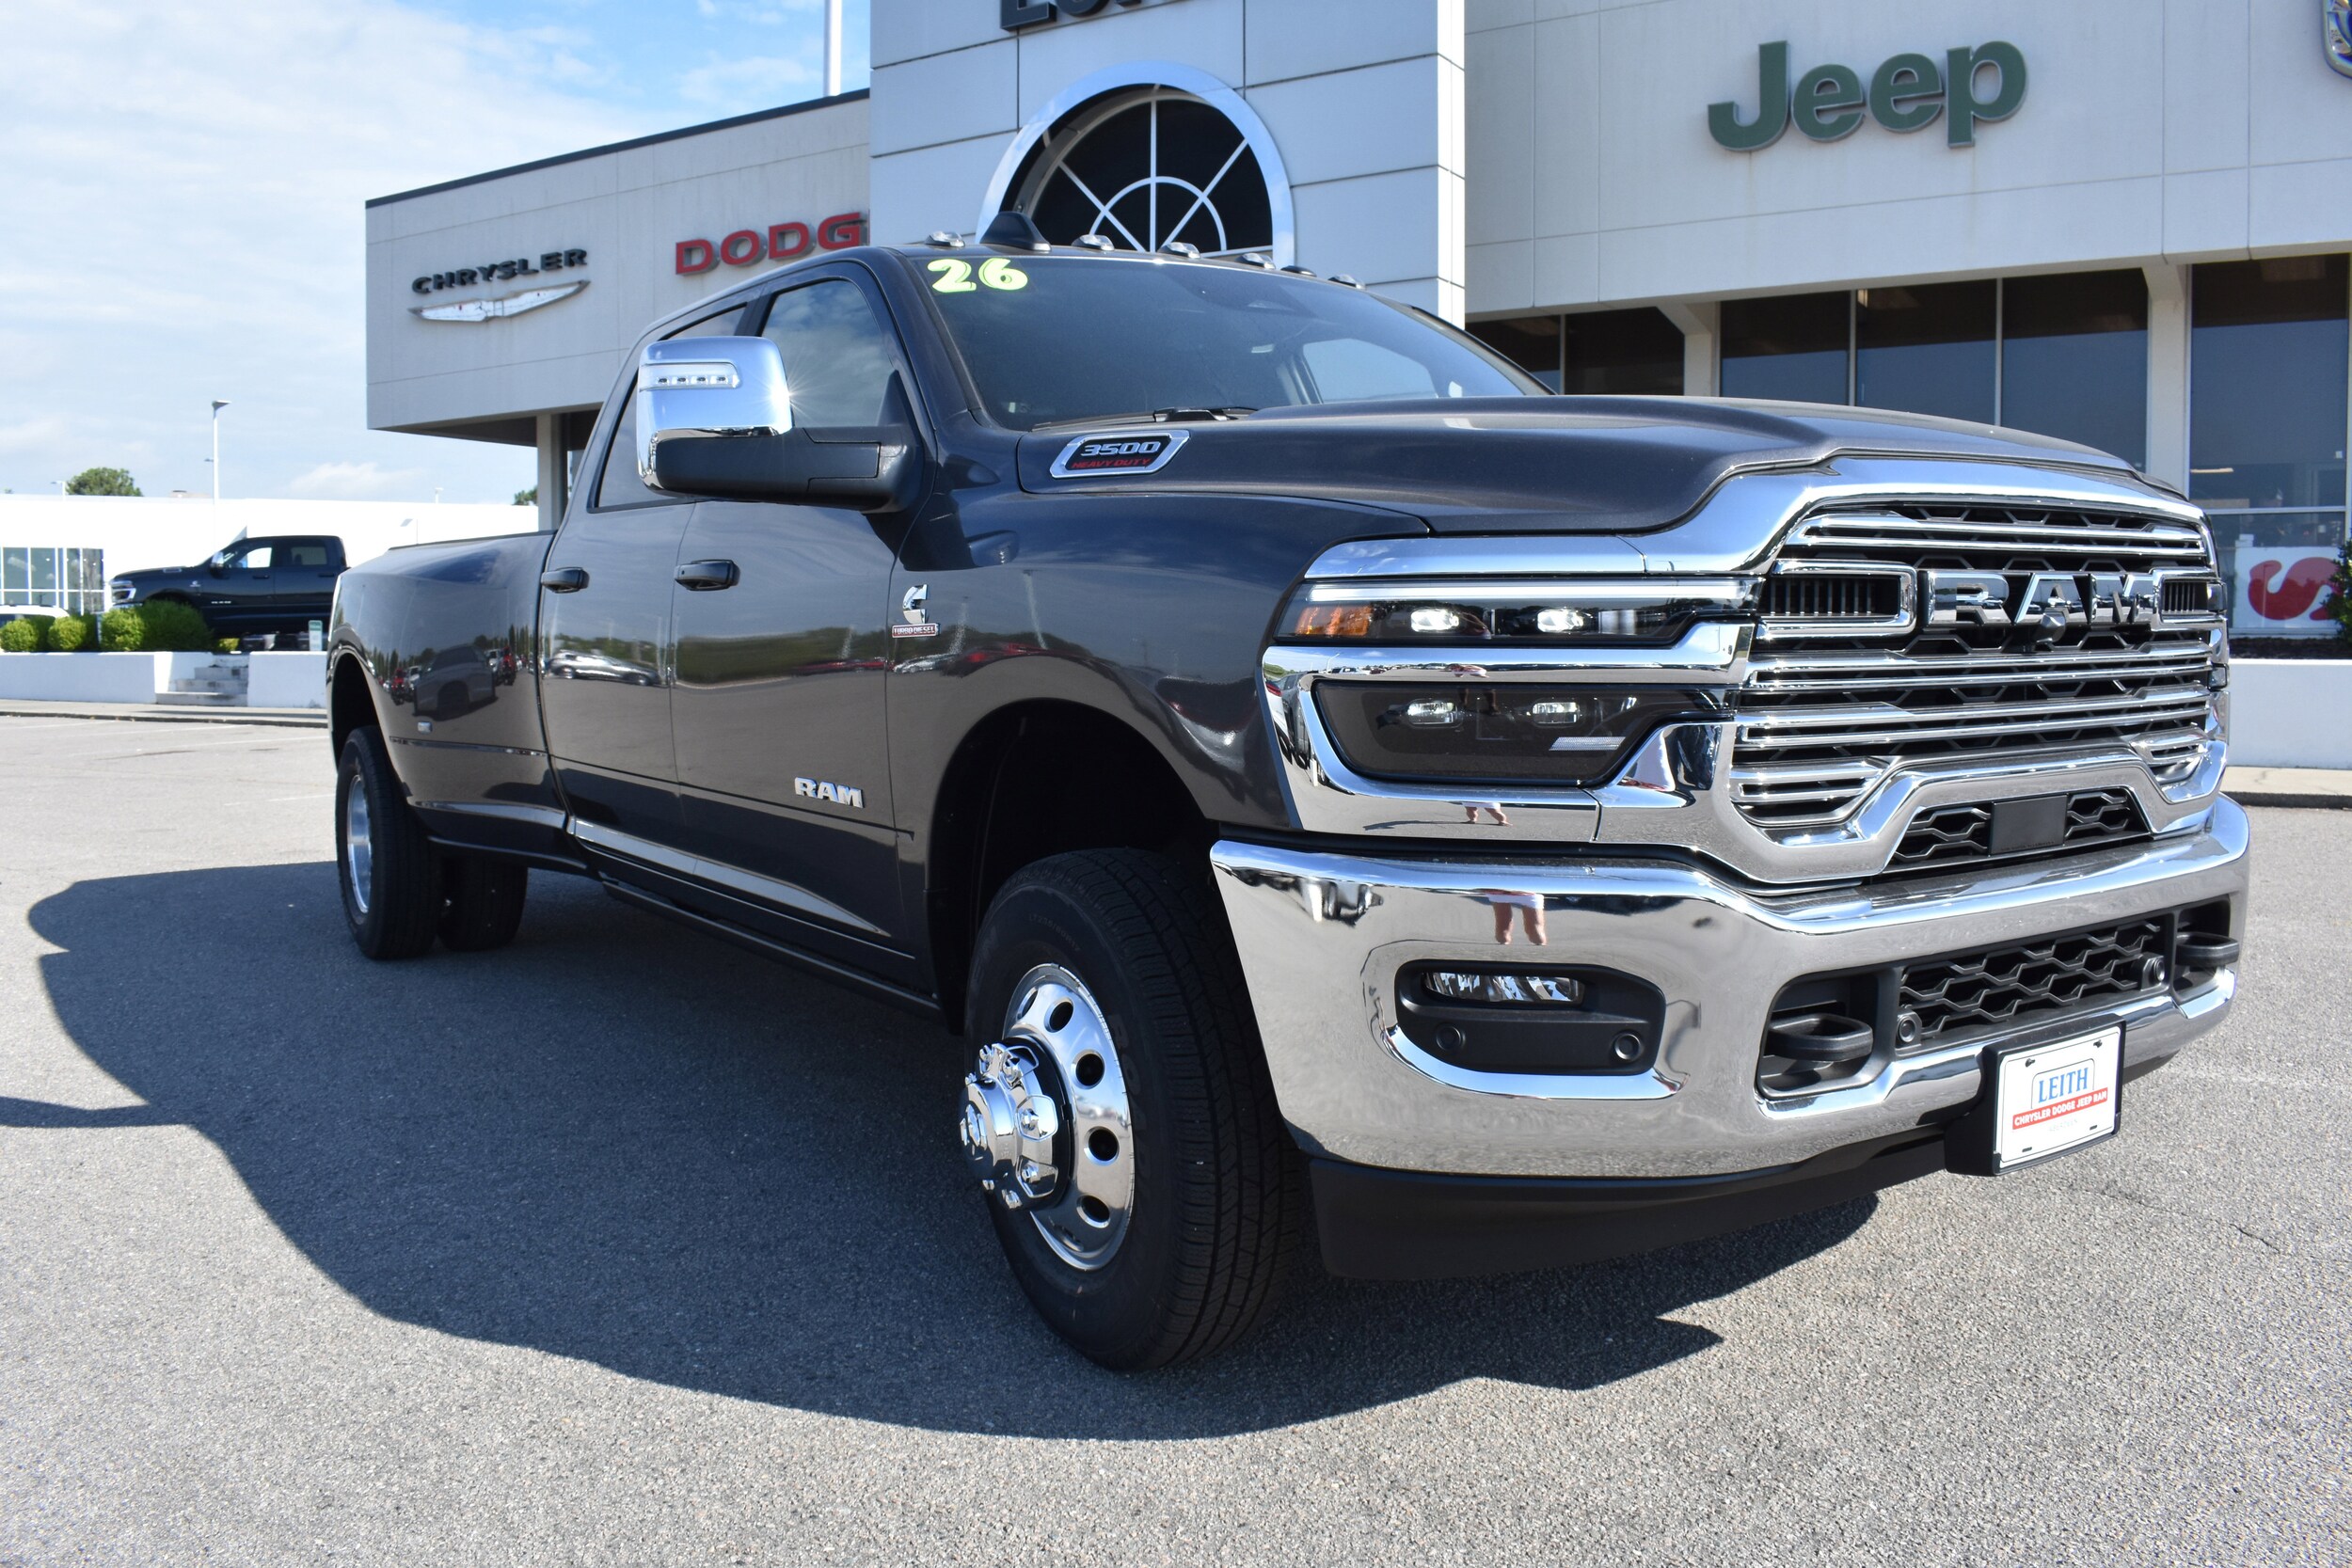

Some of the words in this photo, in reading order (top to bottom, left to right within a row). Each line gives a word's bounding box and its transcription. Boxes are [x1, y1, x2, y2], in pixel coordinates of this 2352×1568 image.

[1708, 40, 2027, 151] Jeep
[675, 213, 870, 275] DODG
[412, 248, 587, 294] CHRYSLER
[927, 257, 1028, 293] 26
[1080, 441, 1161, 457] 3500
[1927, 571, 2155, 626] RAM
[794, 777, 864, 809] RAM
[2038, 1068, 2089, 1103] LEITH
[2014, 1110, 2052, 1126] CHRYSLER
[2052, 1101, 2075, 1117] DODGE
[2076, 1096, 2093, 1110] JEEP
[2093, 1090, 2107, 1102] RAM
